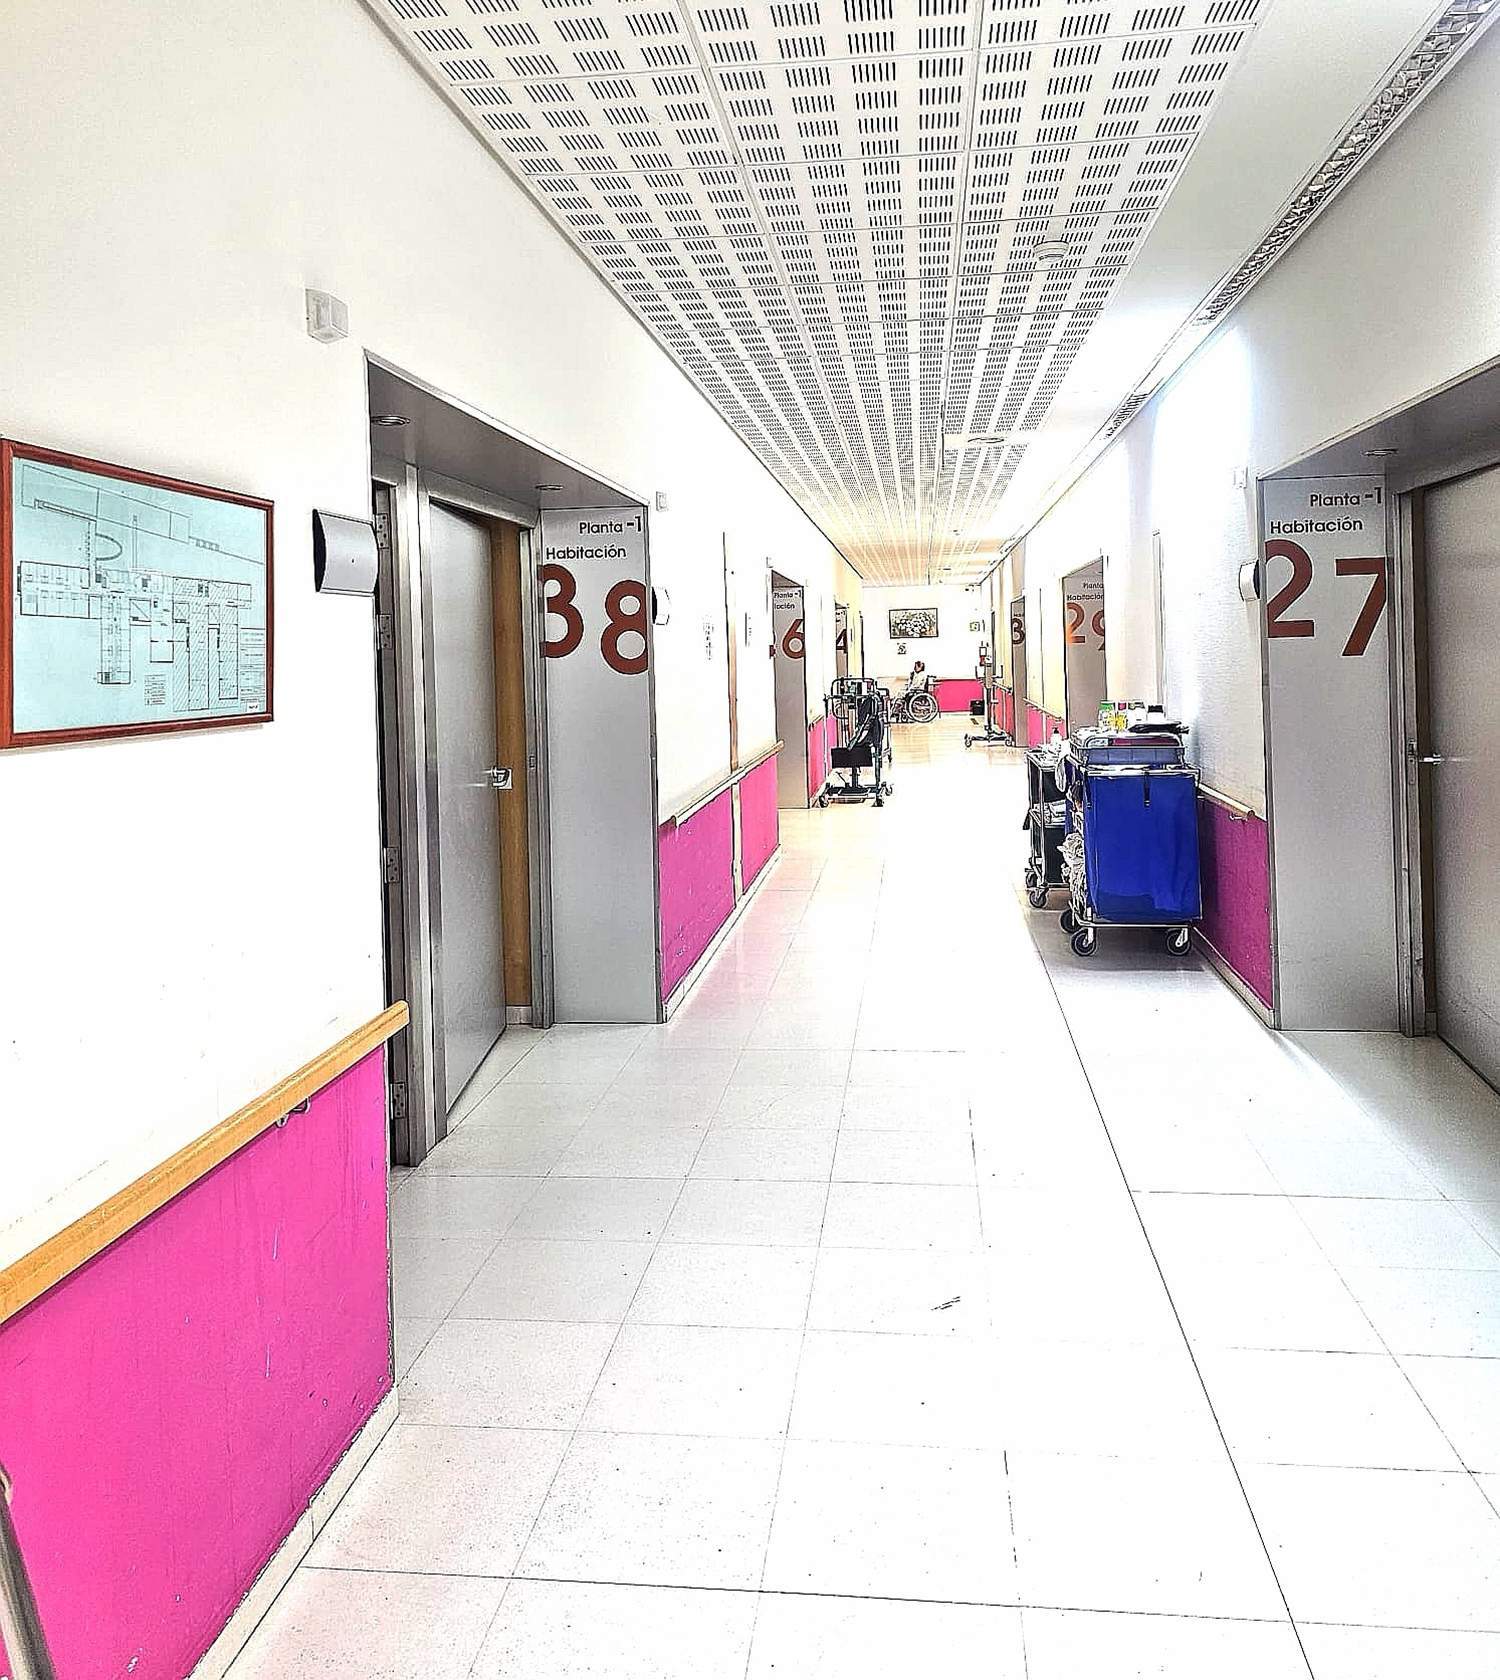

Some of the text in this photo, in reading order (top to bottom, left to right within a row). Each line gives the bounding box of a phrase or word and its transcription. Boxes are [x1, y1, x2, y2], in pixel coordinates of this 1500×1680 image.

[1309, 486, 1383, 507] Planta -1
[579, 515, 642, 534] Planta -1
[1269, 516, 1364, 534] Habitación
[545, 544, 627, 560] Habitación
[1264, 538, 1390, 657] 27
[537, 563, 649, 675] 38
